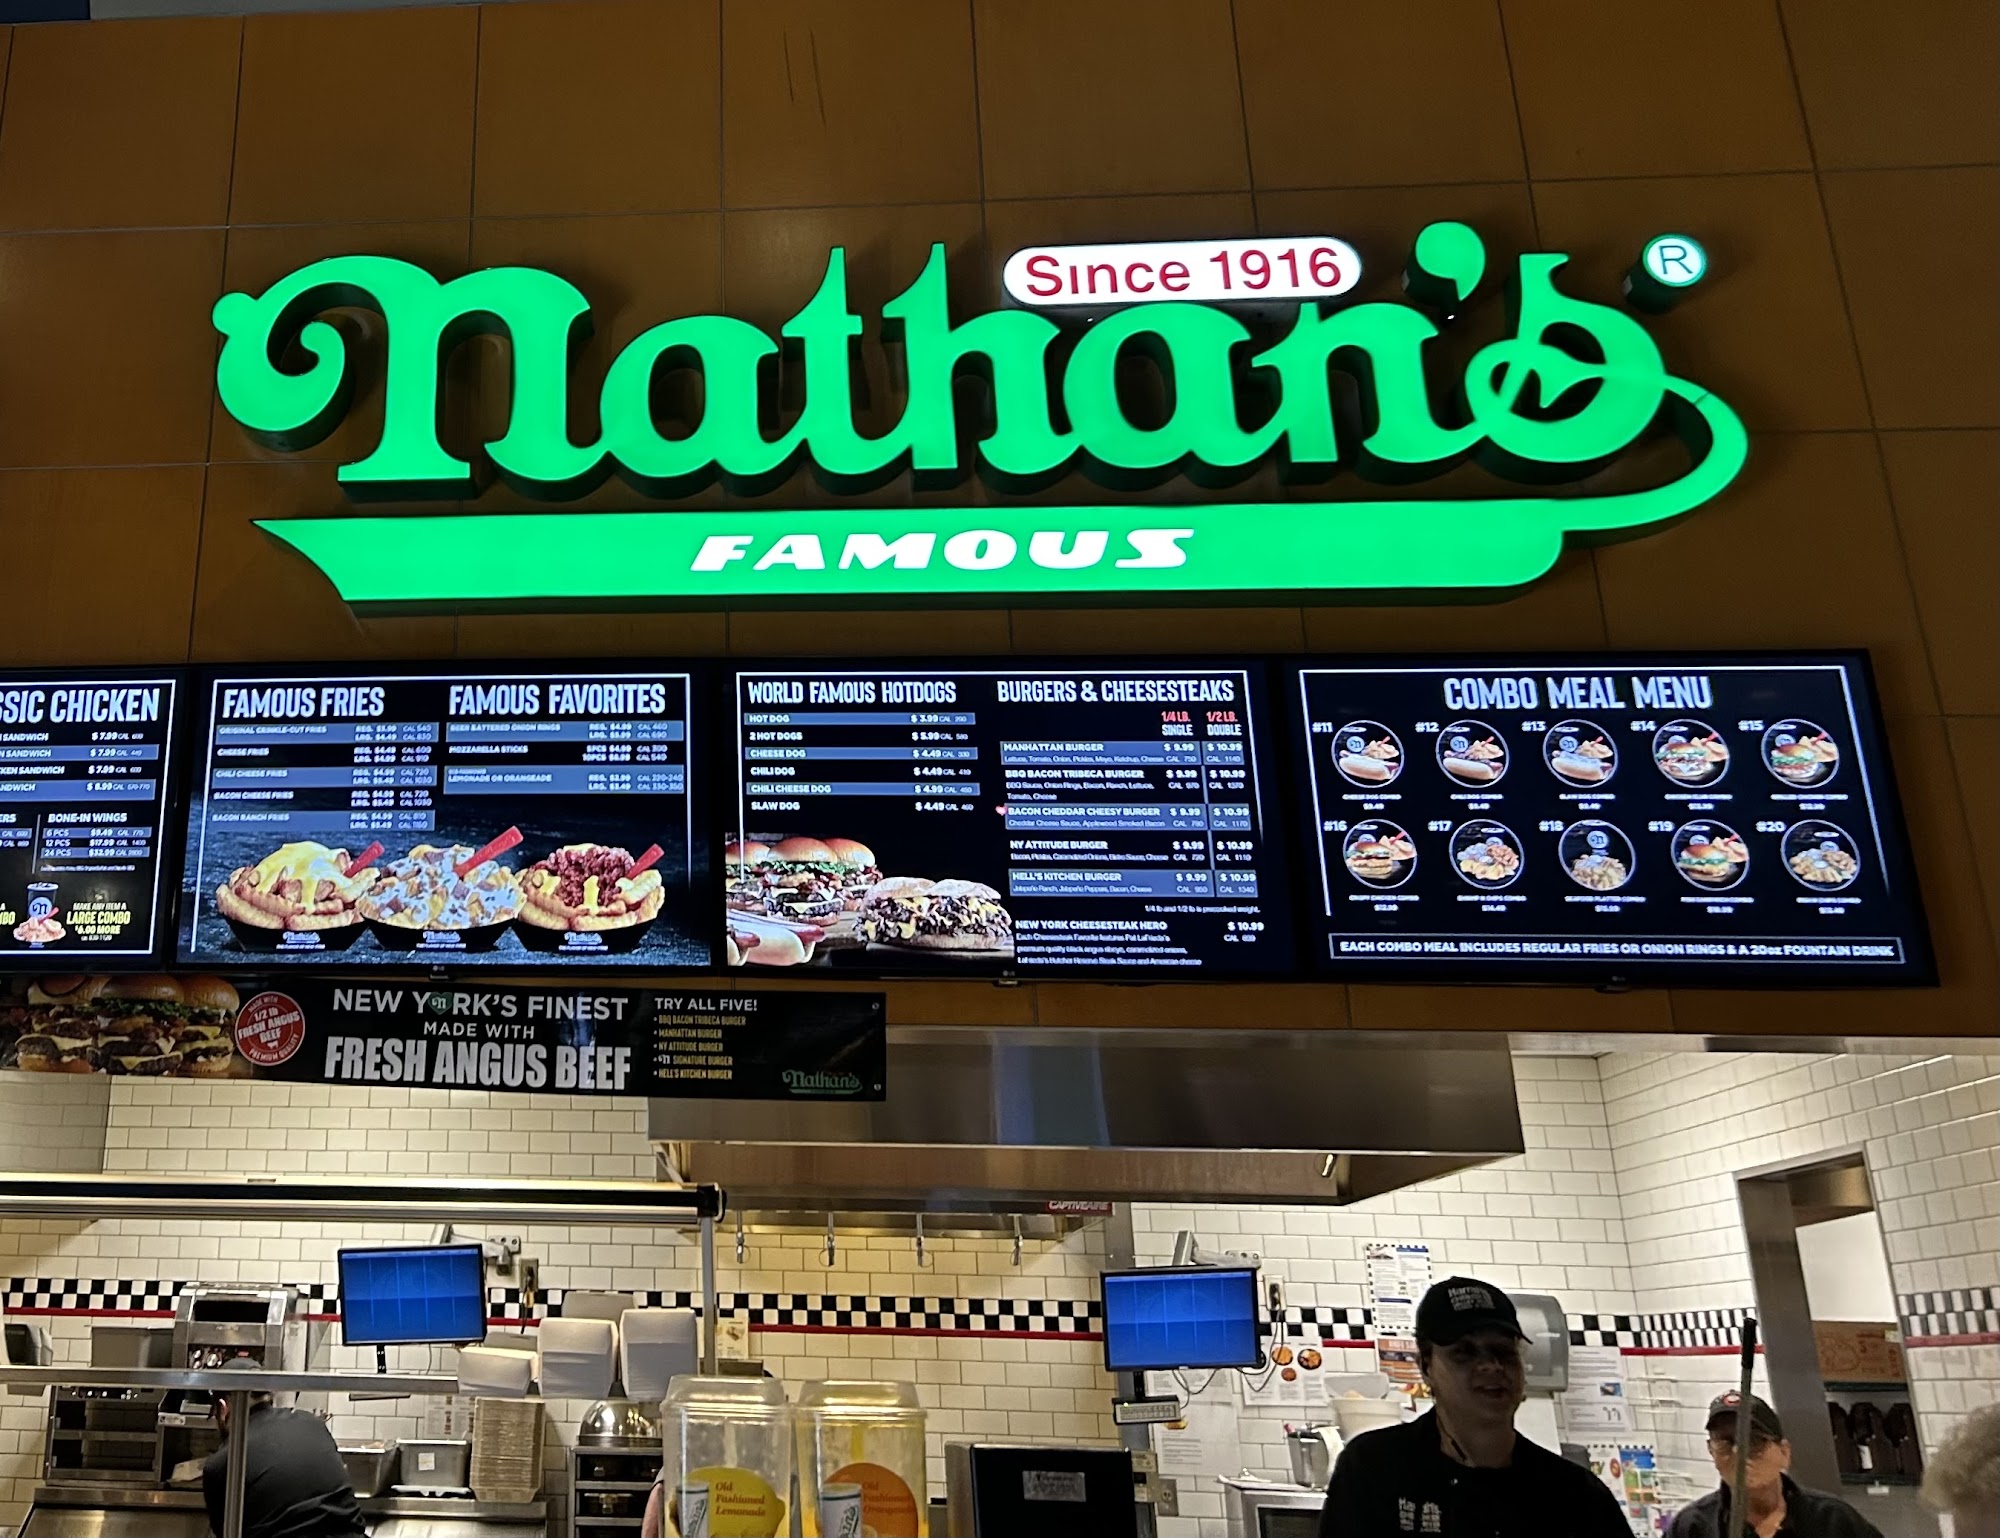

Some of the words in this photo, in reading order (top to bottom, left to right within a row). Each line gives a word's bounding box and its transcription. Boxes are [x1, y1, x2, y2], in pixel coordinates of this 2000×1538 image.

[1025, 250, 1195, 298] Since
[1205, 242, 1345, 292] 1916
[210, 220, 1750, 482] Nathan's
[690, 525, 1195, 572] FAMOUS
[748, 682, 803, 703] WORLD
[809, 681, 876, 703] FAMOUS
[882, 681, 956, 703] HOTDOGS
[997, 681, 1076, 702] BURGERS
[1081, 681, 1098, 702] &
[1101, 679, 1234, 701] CHEESESTEAKS
[1444, 678, 1538, 710] COMBO
[1547, 677, 1626, 709] MEAL
[1632, 676, 1713, 709] MENU
[222, 688, 316, 718] FAMOUS
[320, 687, 385, 717] FRIES
[449, 685, 540, 715] FAMOUS
[549, 683, 665, 714] FAVORITES
[0, 690, 45, 723] SIC
[50, 688, 160, 723] CHICKEN
[1162, 712, 1176, 721] 1/4
[1178, 712, 1191, 721] LB.
[1207, 711, 1222, 721] 1/2
[1224, 711, 1238, 721] LB.
[1162, 725, 1193, 735] SINGLE
[1207, 724, 1242, 735] DOUBLE
[1312, 722, 1333, 733] #11
[1416, 722, 1440, 733] #12
[1522, 722, 1546, 732] #13
[3, 733, 49, 741] SANDWICH
[750, 732, 756, 741] 2
[757, 732, 776, 741] HOT
[777, 732, 802, 741] DOGS
[1065, 743, 1104, 751] BURGER
[750, 750, 785, 758] CHEESE
[786, 750, 806, 758] DOG
[19, 766, 65, 774] SANDWICH
[750, 767, 774, 776] CHILI
[775, 767, 795, 776] DOG
[1005, 770, 1026, 778] BBQ
[1027, 770, 1062, 778] BACON
[1063, 770, 1103, 778] TRIBECA
[1105, 770, 1144, 778] BURGER
[751, 785, 774, 793] CHILI
[775, 785, 809, 793] CHEESE
[811, 785, 831, 793] DOG
[752, 802, 778, 810] SLAW
[779, 802, 800, 810] DOG
[1008, 808, 1041, 816] BACON
[1042, 808, 1086, 816] CHEDDAR
[1087, 808, 1122, 816] CHEESY
[48, 814, 91, 823] BONE-IN
[92, 813, 127, 822] WINGS
[1428, 821, 1451, 831] #17
[1010, 841, 1023, 849] NY
[1025, 841, 1069, 849] ATTITUDE
[1070, 841, 1108, 849] BURGER
[1013, 873, 1043, 881] HELL'S
[1044, 873, 1083, 881] KITCHEN
[1085, 873, 1121, 881] BURGER
[66, 911, 96, 925] LARGE
[98, 911, 131, 924] COMBO
[1015, 921, 1038, 930] NEW
[1040, 921, 1068, 930] YORK
[1070, 921, 1138, 930] CHEESESTEAK
[1140, 922, 1167, 930] HERO
[1341, 942, 1375, 951] EACH
[1376, 942, 1422, 952] COMBO
[1424, 942, 1458, 952] MEAL
[1460, 942, 1520, 952] INCLUDES
[1522, 943, 1581, 953] REGULAR
[1582, 943, 1619, 954] FRIES
[1621, 943, 1640, 954] OR
[1642, 944, 1683, 954] ONION
[1685, 944, 1725, 954] RINGS
[1784, 945, 1850, 956] FOUNTAIN
[1852, 946, 1894, 956] DRINK
[333, 989, 403, 1013] NEW
[528, 996, 628, 1020] FINEST
[655, 998, 683, 1010] TRY
[688, 999, 715, 1010] ALL
[720, 999, 757, 1011] FIVE!
[255, 1010, 268, 1021] 1/2
[659, 1015, 672, 1025] BBQ
[672, 1015, 694, 1024] BACON
[695, 1016, 720, 1025] TRIBECA
[722, 1016, 746, 1025] BURGER
[238, 1021, 266, 1040] FRESH
[268, 1011, 300, 1029] ANGUS
[424, 1022, 476, 1037] MADE
[487, 1024, 535, 1039] WITH
[260, 1027, 281, 1043] BEEF
[659, 1029, 696, 1038] MANHATTAN
[697, 1029, 722, 1039] BURGER
[659, 1042, 668, 1051] NY
[669, 1042, 697, 1051] ATTITUDE
[699, 1042, 723, 1051] BURGER
[325, 1036, 425, 1082] FRESH
[432, 1041, 547, 1087] ANGUS
[556, 1046, 631, 1090] BEEF
[708, 1056, 732, 1066] BURGER
[680, 1069, 706, 1079] KITCHEN
[708, 1070, 732, 1080] BURGER
[715, 1482, 732, 1491] Old
[715, 1505, 766, 1516] Lemonade
